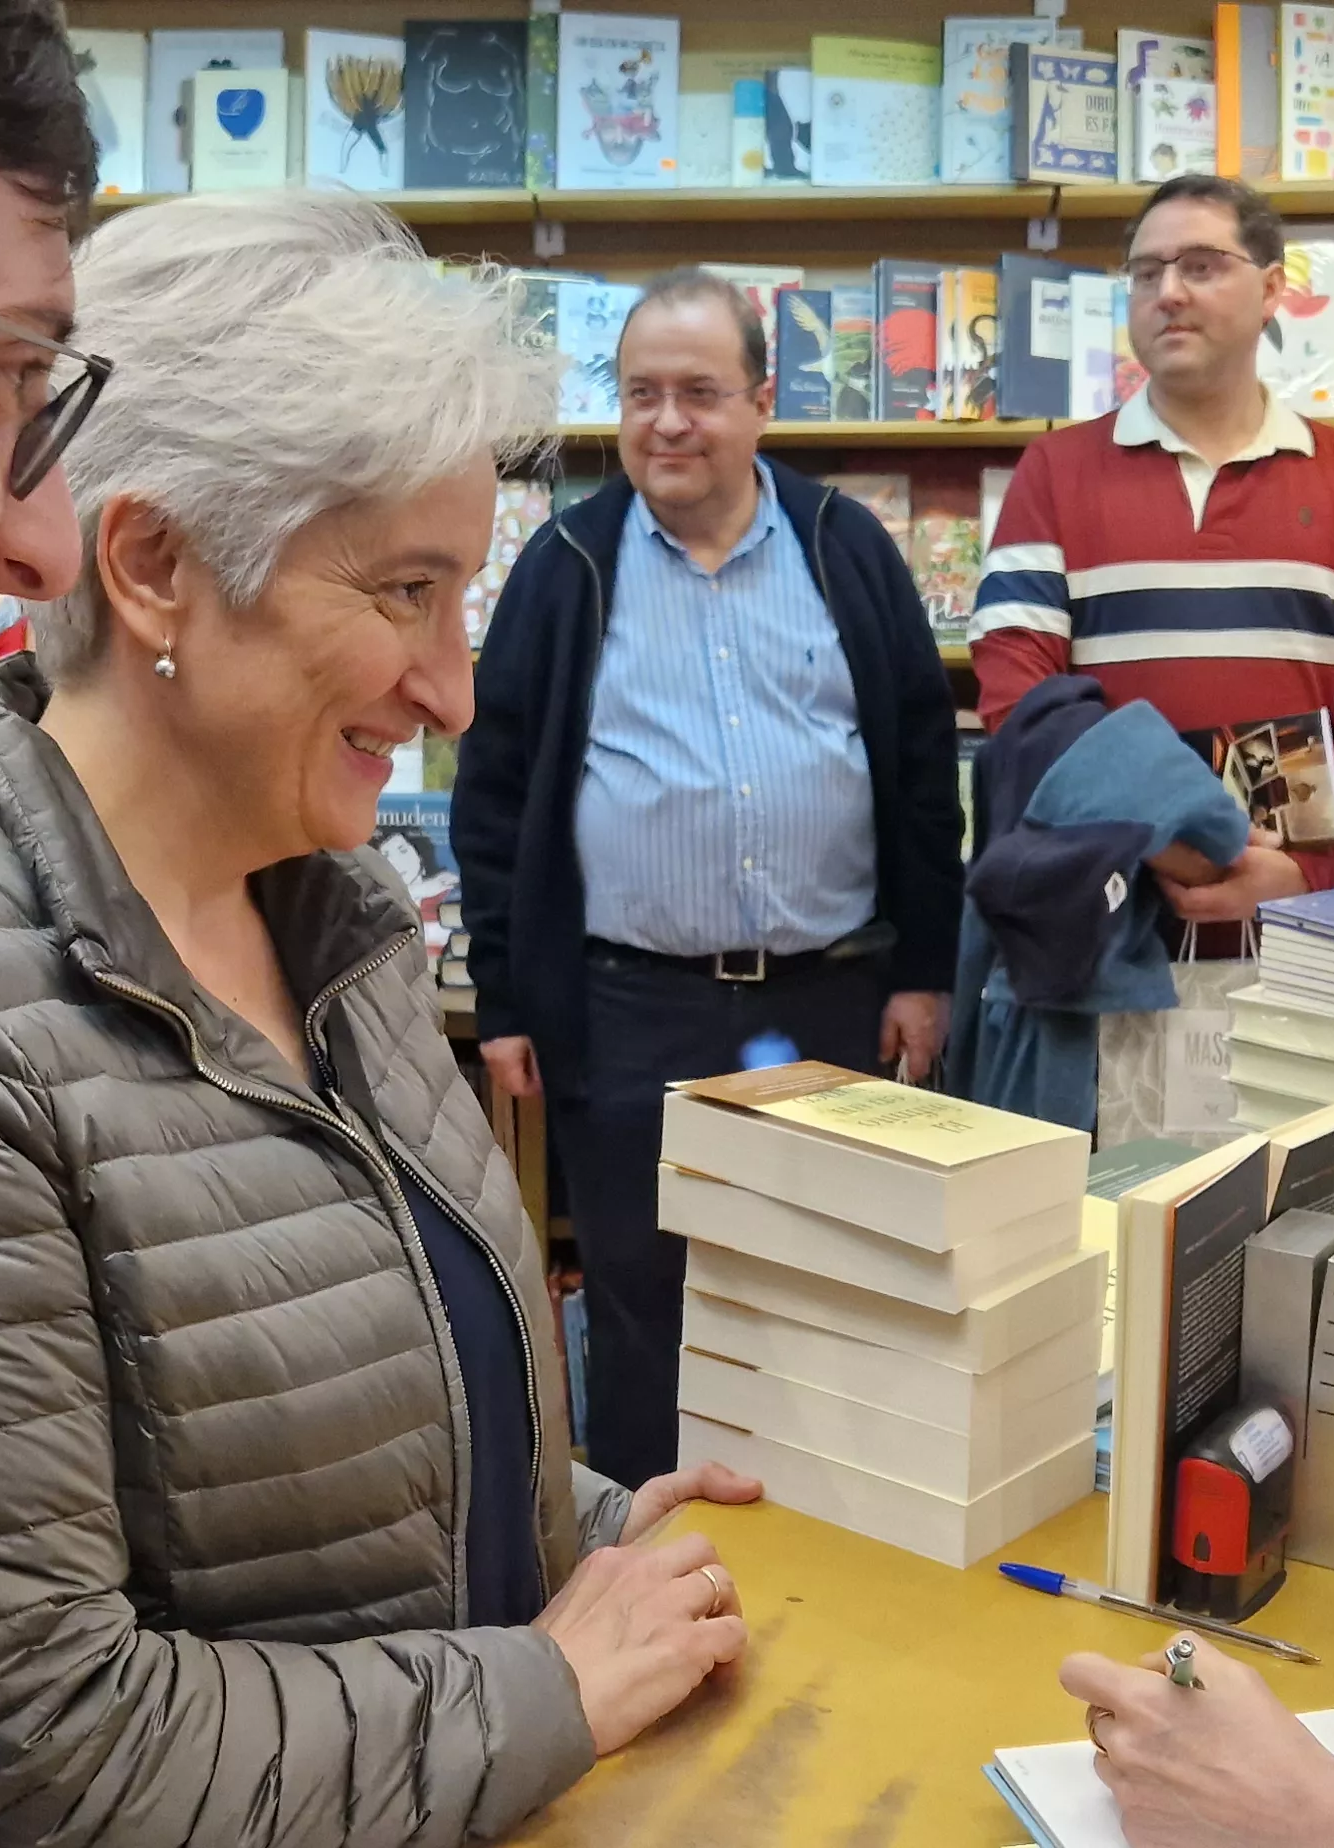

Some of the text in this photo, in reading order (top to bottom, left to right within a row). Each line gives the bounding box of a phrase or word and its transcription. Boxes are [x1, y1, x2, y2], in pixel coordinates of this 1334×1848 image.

[376, 801, 450, 827] muden
[1184, 1031, 1227, 1066] MAS
[831, 1101, 868, 1116] un
[857, 1101, 964, 1128] infinito
[931, 1119, 974, 1134] El
